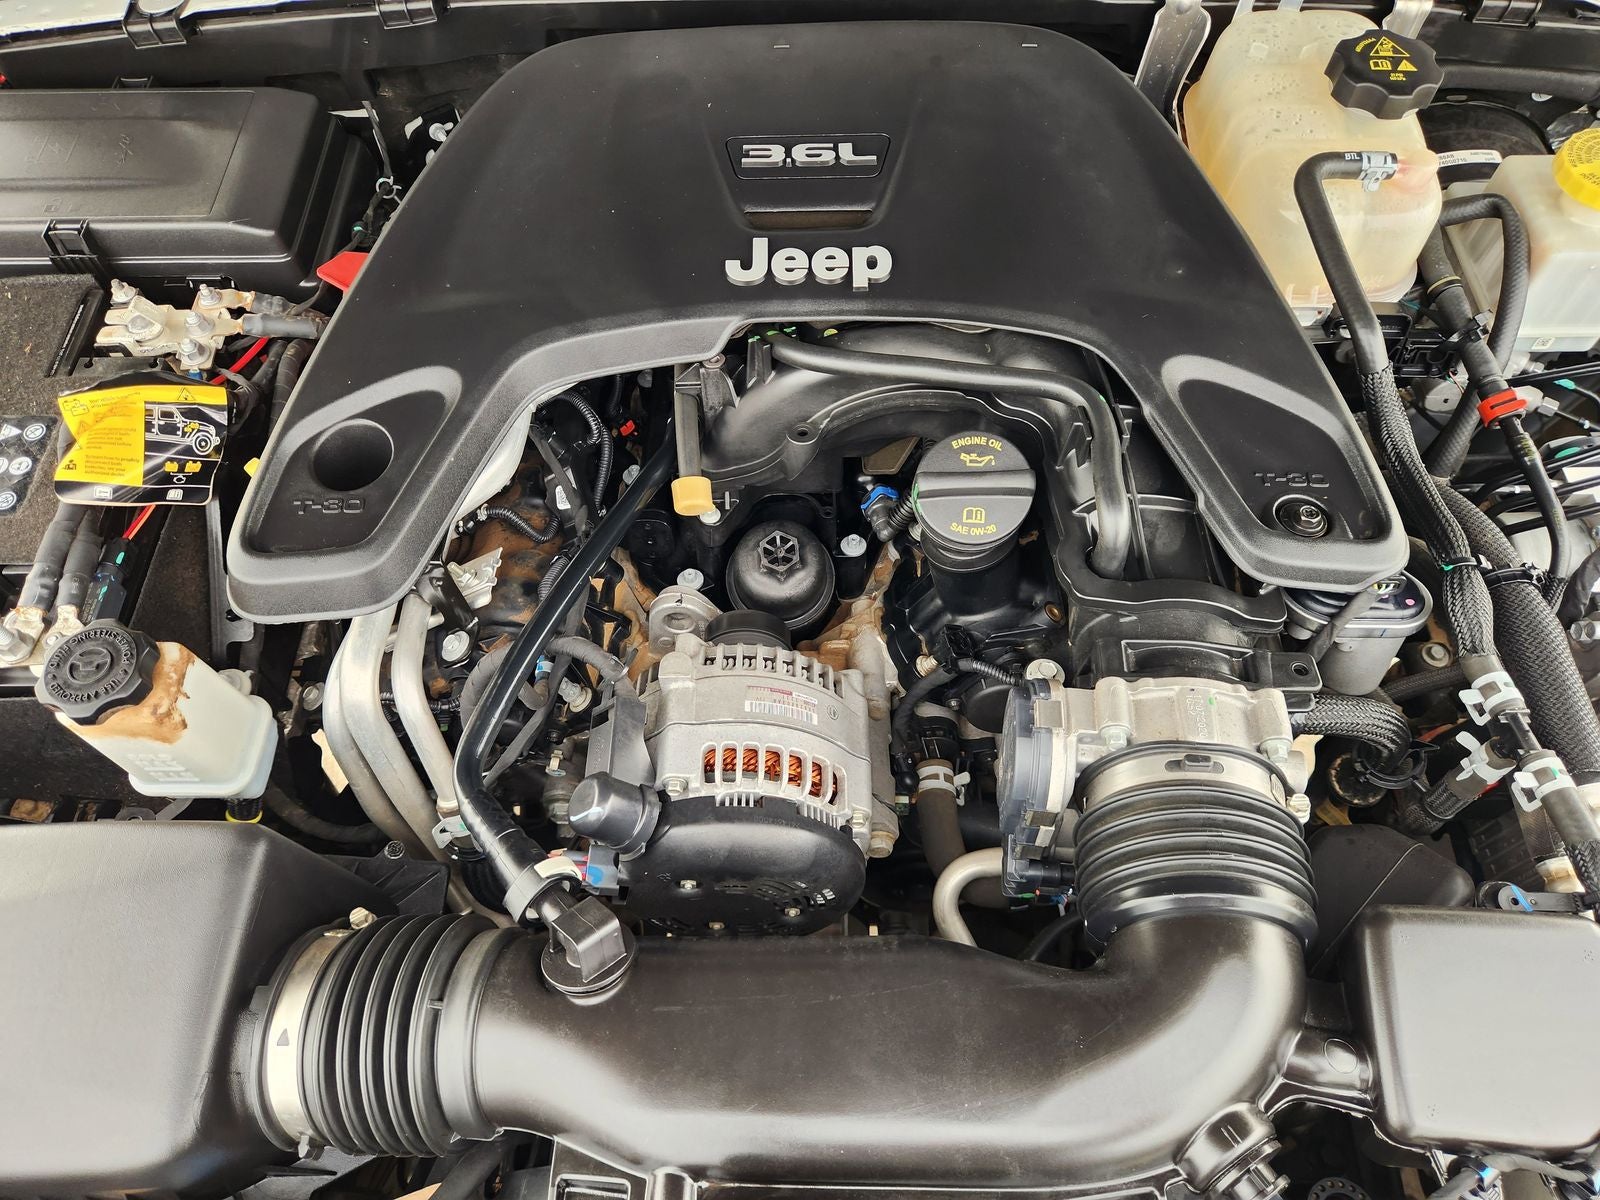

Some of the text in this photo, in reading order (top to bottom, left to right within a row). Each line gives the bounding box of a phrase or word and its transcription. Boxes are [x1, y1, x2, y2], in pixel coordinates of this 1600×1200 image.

[741, 142, 878, 168] 3.6L
[725, 237, 893, 292] Jeep
[951, 436, 1002, 451] ENGINE OIL
[950, 522, 969, 535] SAE
[69, 629, 117, 645] STEERING
[49, 644, 71, 668] FLUID
[50, 678, 121, 702] USE APPROVED
